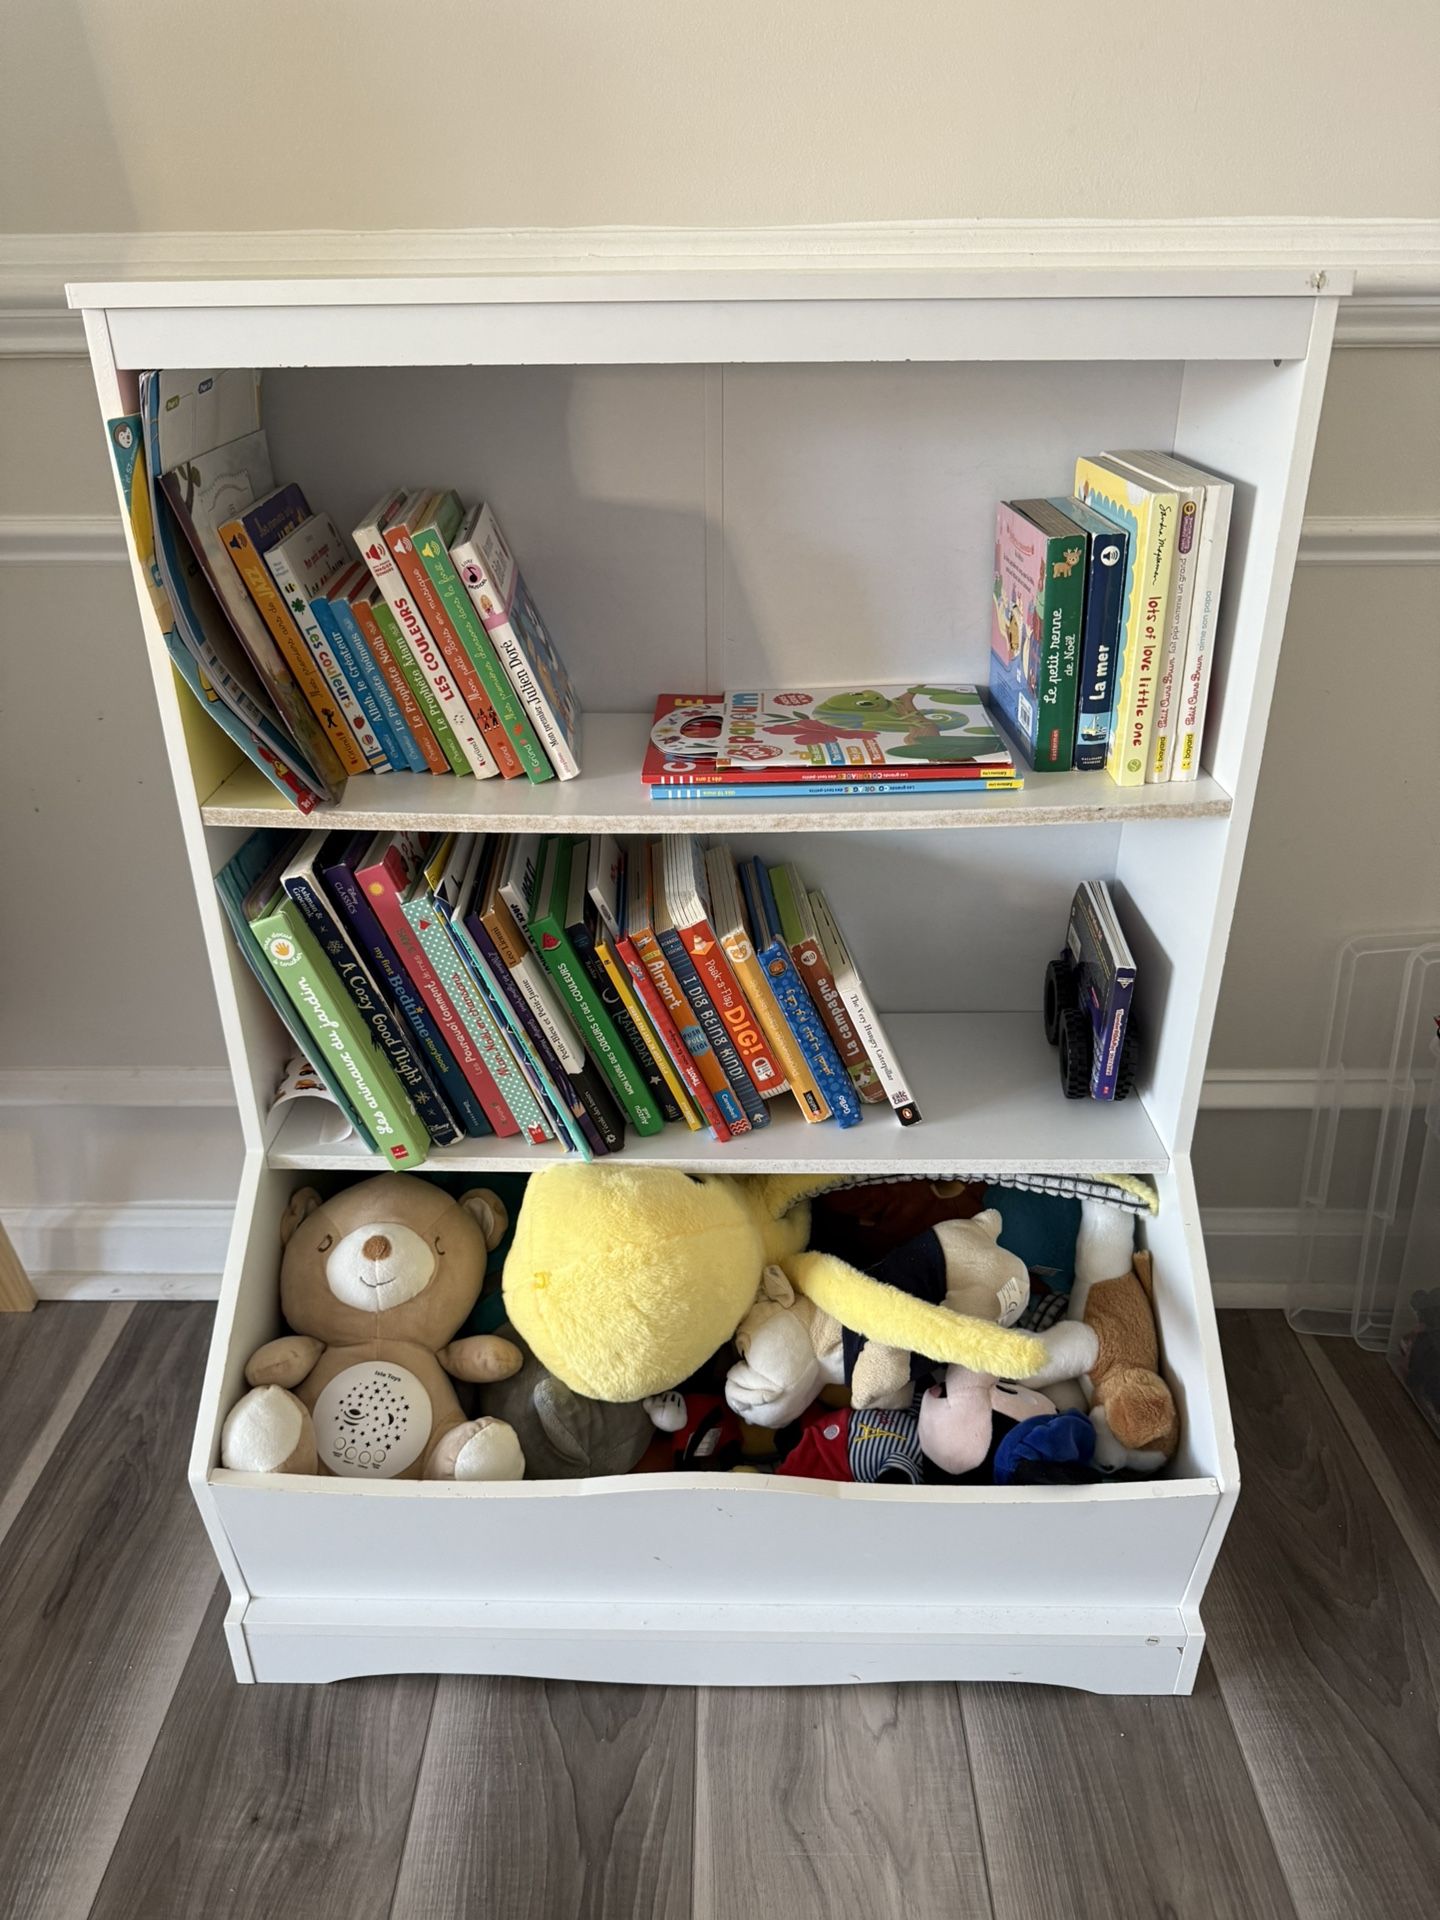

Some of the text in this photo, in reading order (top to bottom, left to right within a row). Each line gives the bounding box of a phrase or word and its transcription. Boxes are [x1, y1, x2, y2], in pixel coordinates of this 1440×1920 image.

[243, 563, 272, 603] JAZZ
[1176, 557, 1189, 582] grand
[442, 585, 455, 598] la
[1177, 583, 1184, 593] un
[449, 596, 468, 621] dans
[409, 565, 483, 704] Mon petit Paris en musique
[459, 620, 488, 661] chansons
[1169, 625, 1180, 640] pipi
[330, 628, 361, 679] Créateur
[392, 596, 455, 701] LES COULEURS
[1044, 607, 1063, 703] Le petit renne
[1064, 633, 1075, 675] de Noël
[1167, 640, 1177, 654] fait
[1184, 590, 1213, 725] Petit Ours Brun aime son papa
[305, 624, 325, 649] Les
[317, 648, 355, 710] couleurs
[1088, 644, 1109, 701] La mer
[1131, 594, 1161, 747] lots of love little one
[1162, 656, 1175, 683] Brun
[354, 679, 367, 691] le
[370, 672, 399, 718] Prophète
[385, 664, 417, 714] Prophète
[408, 666, 441, 717] Prophète
[497, 638, 559, 747] Mon premier Julien Doré
[1159, 684, 1172, 707] Ours
[393, 719, 405, 731] Le
[410, 713, 424, 729] Le
[434, 716, 448, 731] Le
[1156, 707, 1169, 728] Petit
[467, 739, 485, 762] Gründ
[499, 744, 514, 766] Gründ
[523, 743, 540, 767] Gründ
[1156, 735, 1166, 761] bayard
[1183, 733, 1194, 759] bayard
[291, 886, 315, 919] Groenink
[297, 883, 323, 919] Ashman &
[333, 880, 358, 915] CLASSICS
[509, 902, 525, 923] JACK
[490, 925, 508, 950] Lionni
[412, 953, 426, 972] mes
[421, 970, 431, 980] de
[555, 961, 585, 1002] COULEURS
[645, 956, 688, 1011] Airport
[682, 974, 695, 985] I
[747, 978, 763, 998] bois
[423, 979, 454, 1023] Comment
[449, 971, 478, 1018] chansons
[520, 976, 548, 1018] Petit-Jaune
[578, 1001, 591, 1015] DES
[704, 958, 763, 1057] Peek-a-Flap DIG!
[336, 955, 423, 1088] A Cozy Good Night
[372, 945, 450, 1074] my first Bedtime storybook
[473, 1015, 485, 1030] en
[541, 1017, 550, 1026] et
[585, 1013, 595, 1023] ET
[763, 1010, 779, 1031] dans
[814, 974, 859, 1057] La campagne
[446, 1018, 476, 1064] Pourquoi
[541, 1024, 569, 1063] Petit-Bleu
[588, 1021, 612, 1052] ODEURS
[612, 1008, 656, 1070] RAMADAN
[681, 1028, 700, 1040] PUSH
[686, 1035, 703, 1046] PULL
[848, 993, 898, 1082] The Very Hungry Caterpillar
[293, 972, 394, 1138] Les animaux du jardin
[489, 1051, 512, 1080] Mon
[605, 1051, 618, 1064] DES
[772, 1030, 802, 1077] Promenade
[471, 1061, 483, 1075] Les
[612, 1063, 627, 1081] LIVRE
[621, 1079, 635, 1095] MON
[719, 1092, 739, 1119] Campbell
[374, 1370, 401, 1381] Isle Toys
